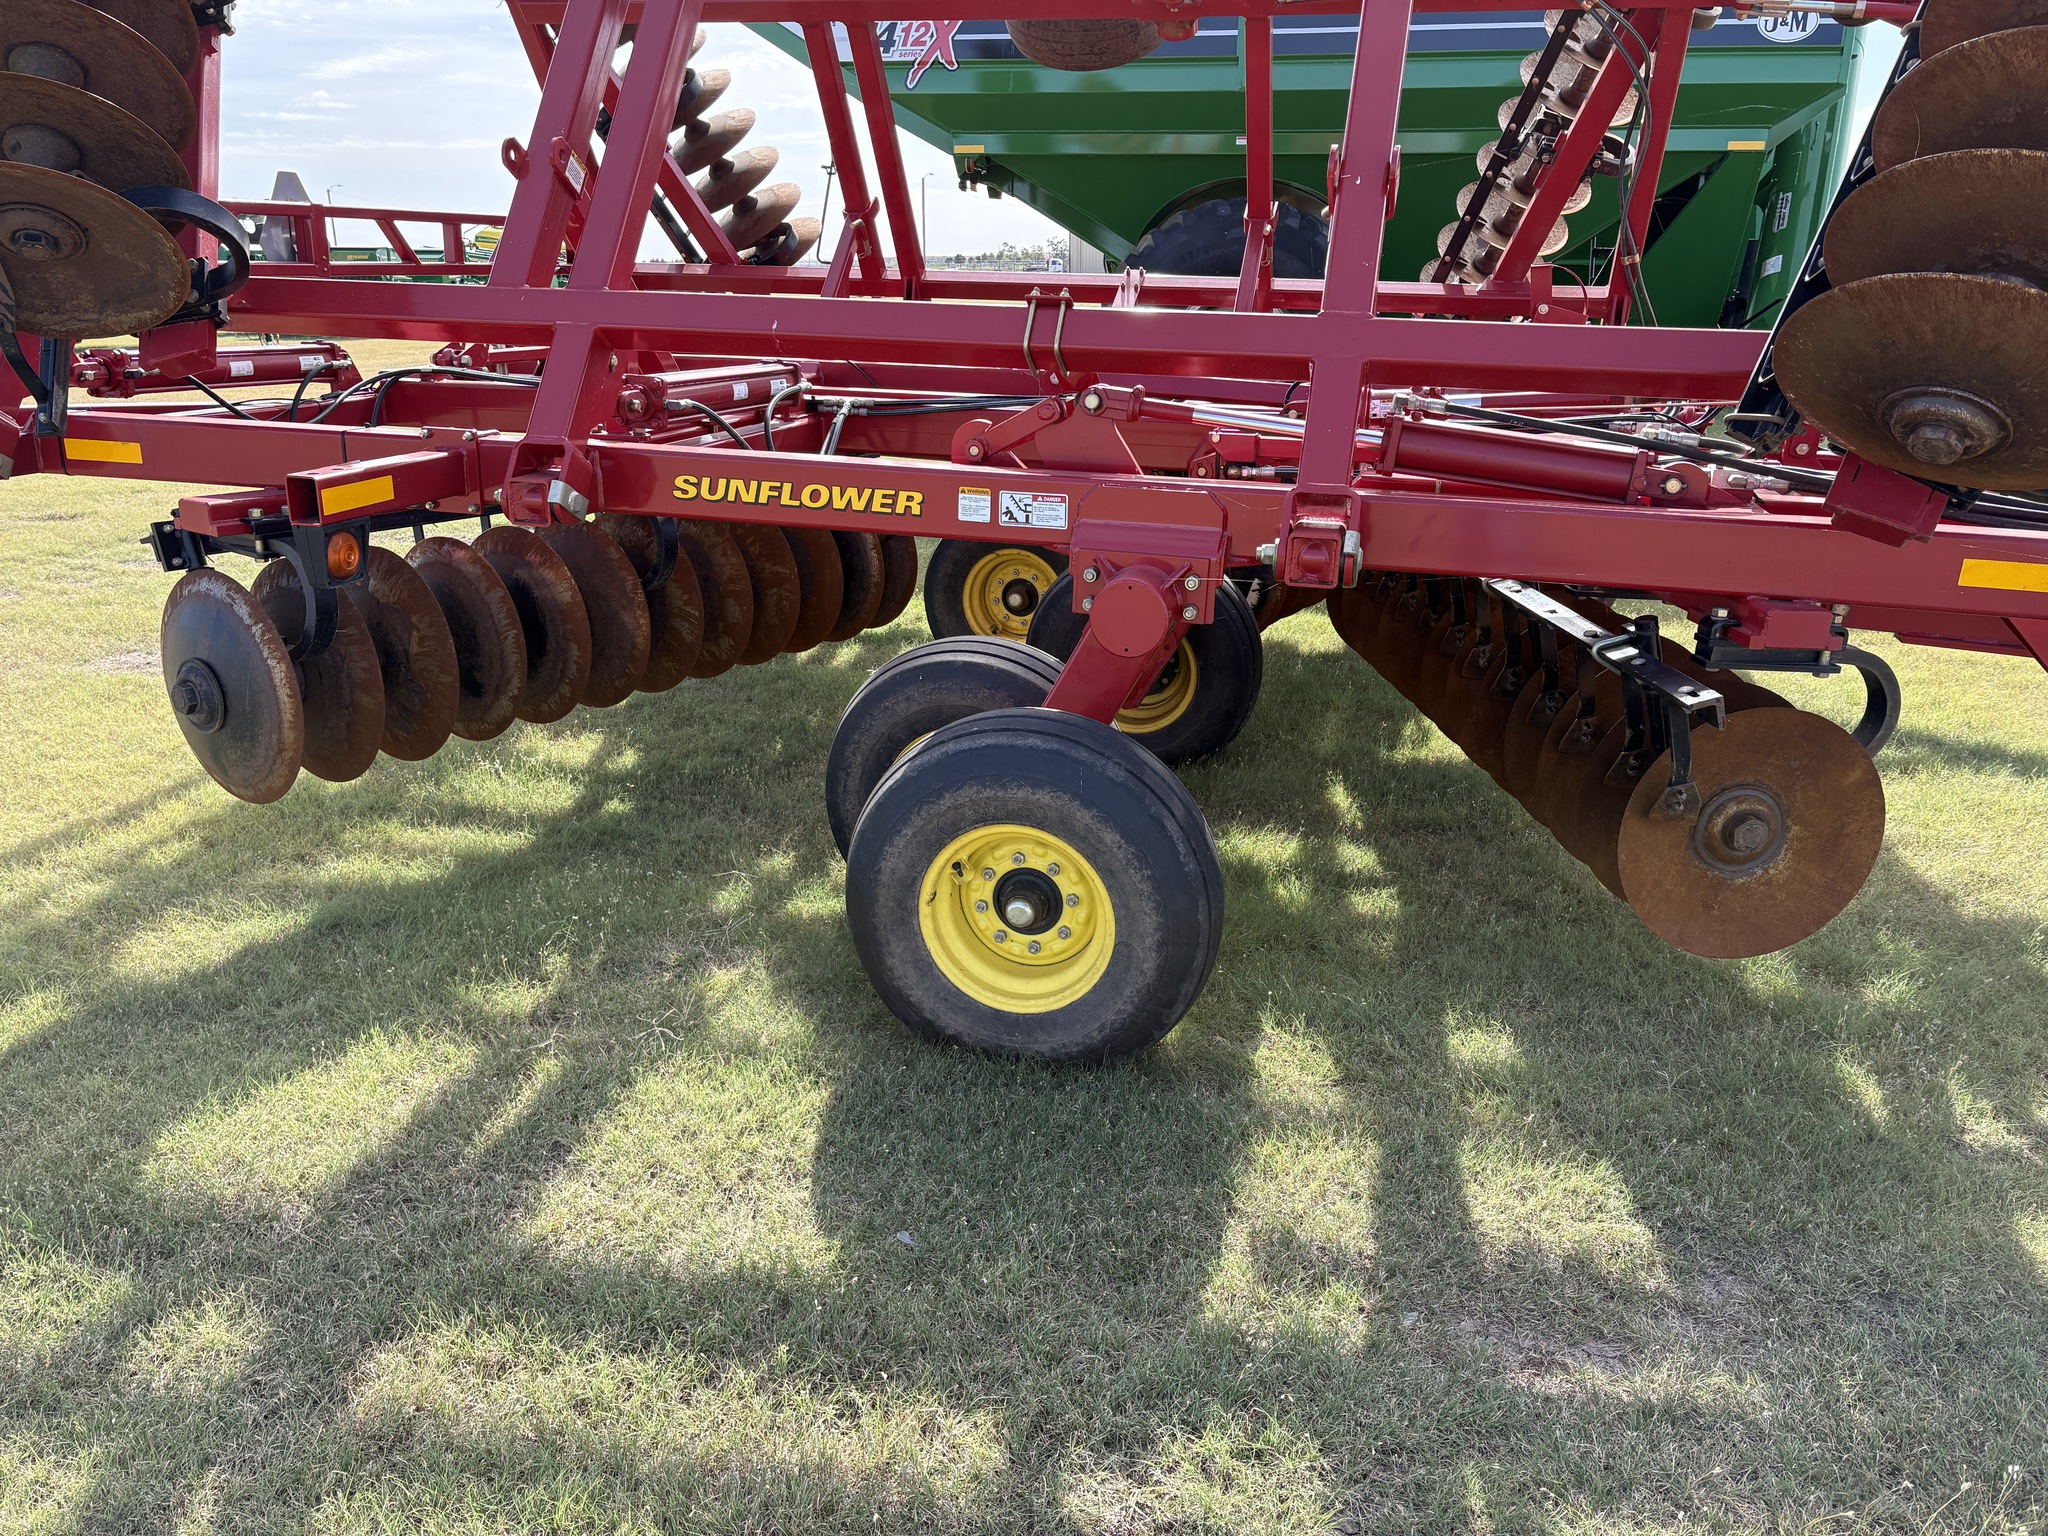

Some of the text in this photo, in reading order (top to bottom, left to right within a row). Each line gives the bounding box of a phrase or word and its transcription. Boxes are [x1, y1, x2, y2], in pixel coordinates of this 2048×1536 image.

[1764, 11, 1807, 32] J&M
[898, 50, 923, 58] series
[672, 474, 925, 517] SUNFLOWER
